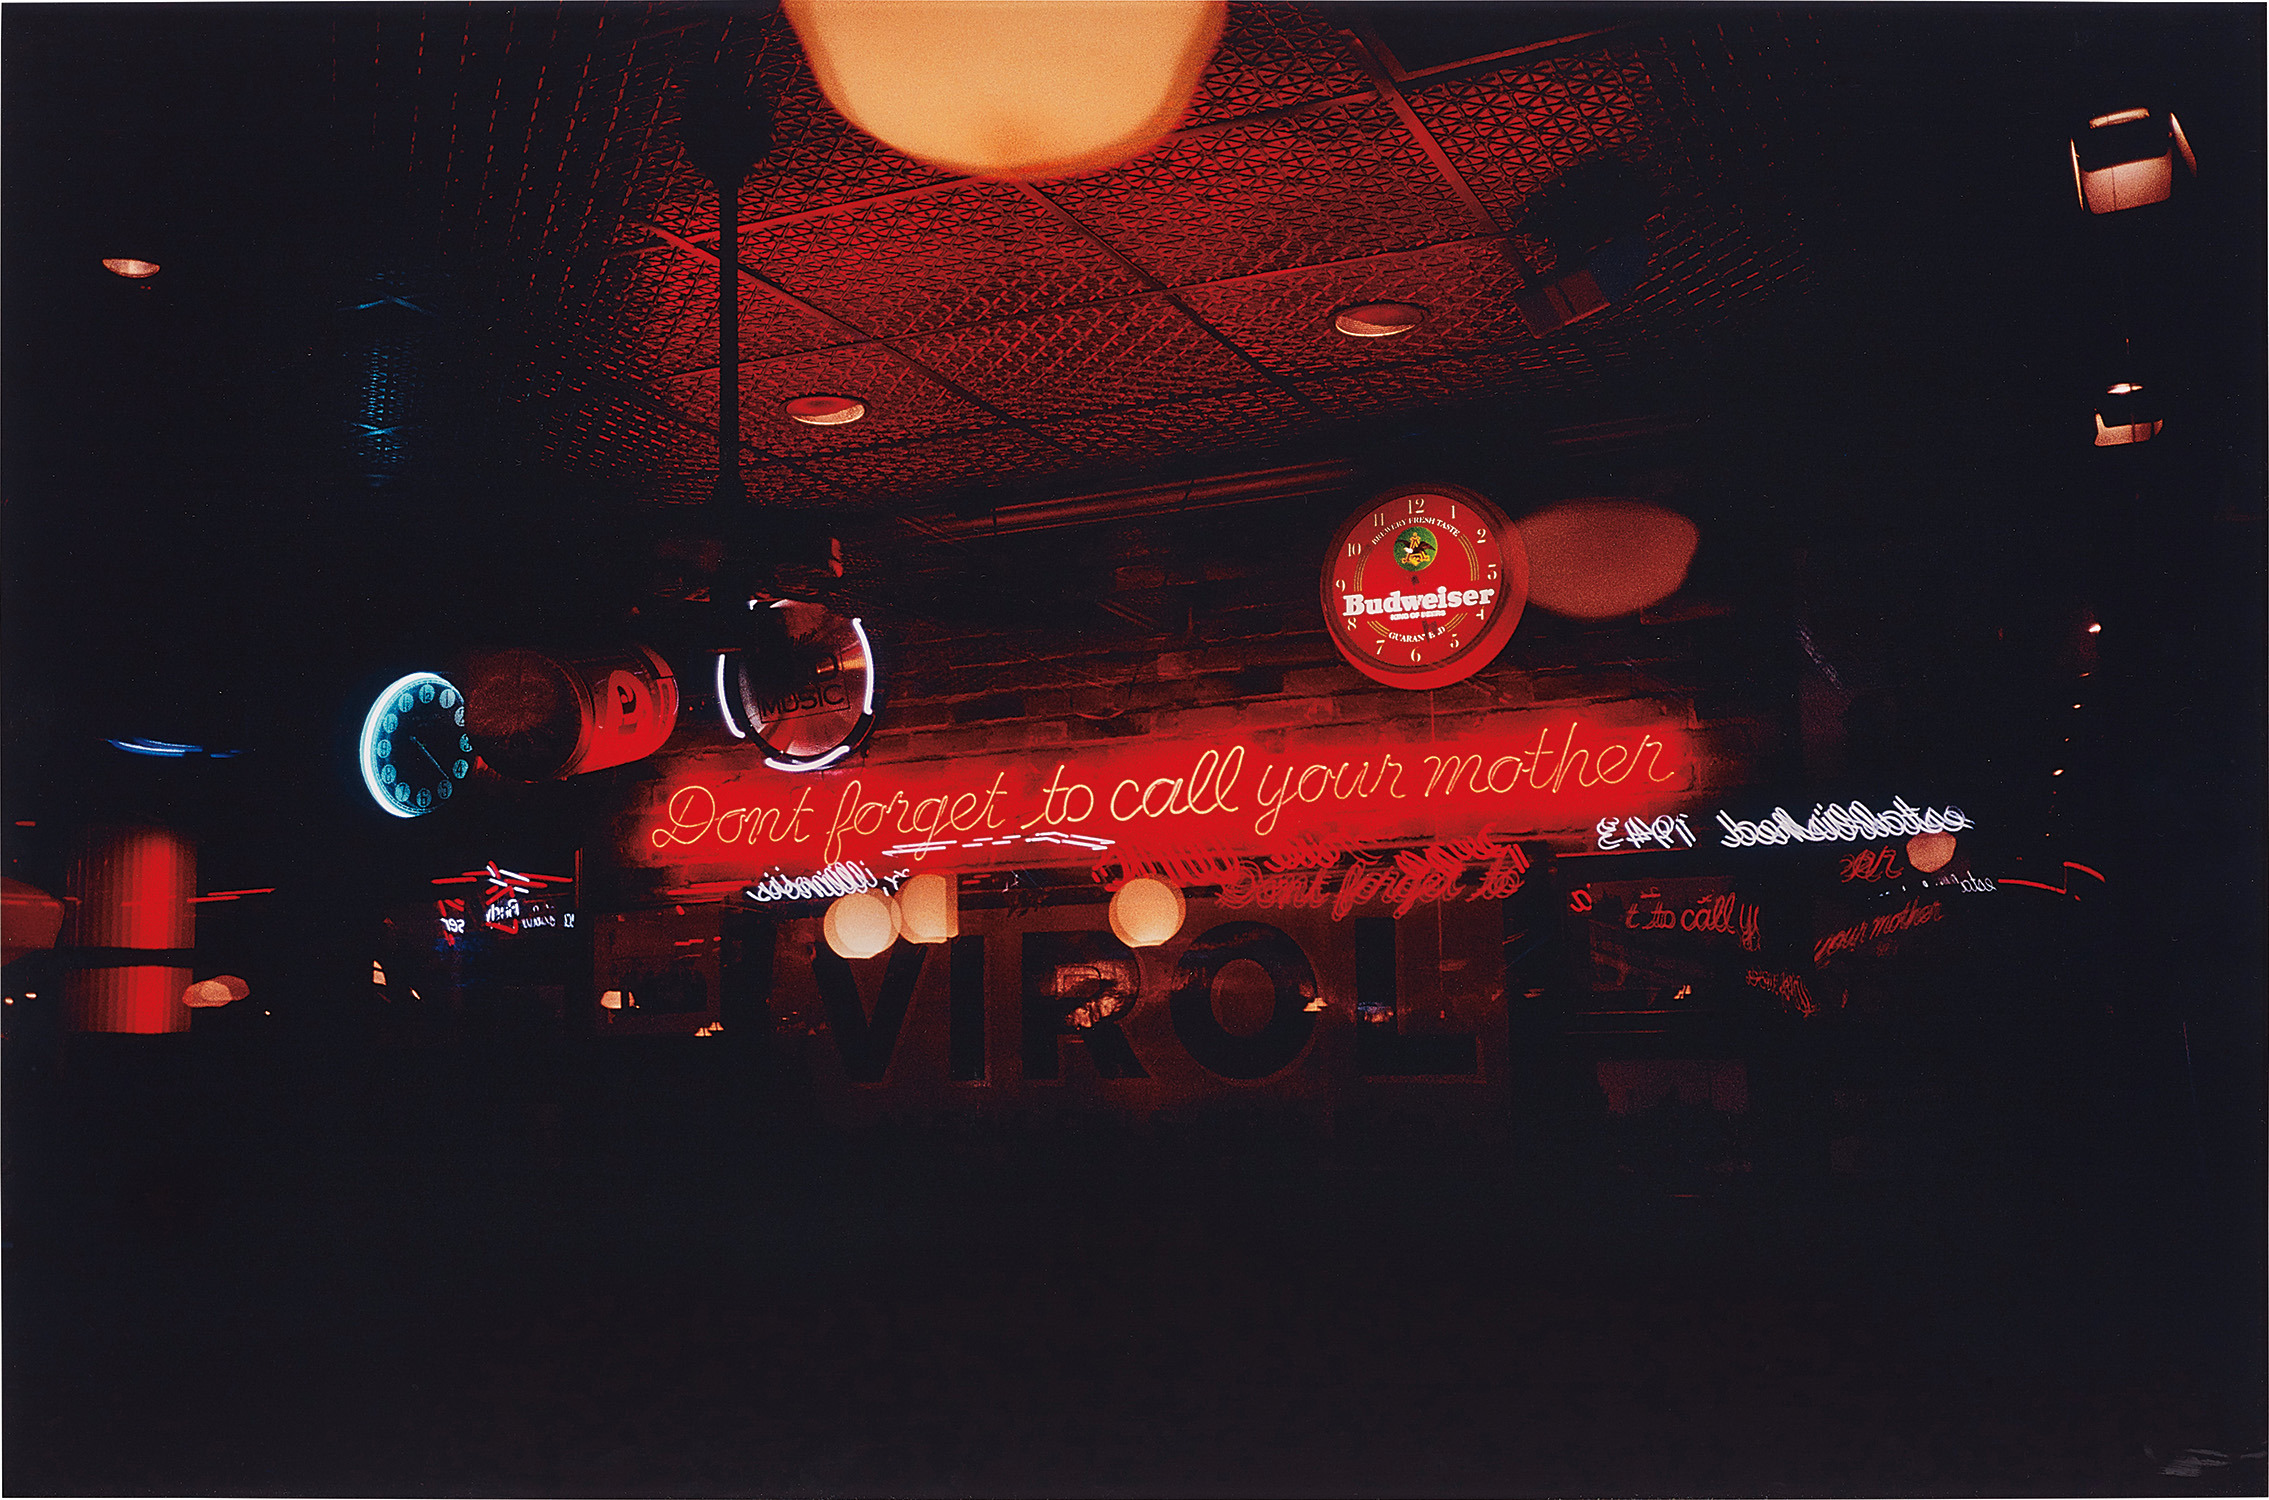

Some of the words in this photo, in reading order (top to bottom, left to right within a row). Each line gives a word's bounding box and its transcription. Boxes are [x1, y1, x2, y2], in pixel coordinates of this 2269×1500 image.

[1408, 498, 1425, 515] 12
[1374, 512, 1384, 527] 11
[1371, 518, 1407, 545] BREWERY
[1408, 516, 1436, 525] FRESH
[1436, 518, 1461, 537] TASTE
[1476, 528, 1487, 544] 2
[1347, 542, 1362, 557] 10
[1335, 579, 1346, 592] 9
[1342, 585, 1495, 617] Budweiser
[1347, 617, 1357, 631] 8
[1375, 640, 1386, 655] 7
[1449, 633, 1460, 649] 5
[1410, 646, 1422, 663] 6
[761, 683, 845, 717] MUSIC
[652, 785, 813, 847] Dont
[825, 772, 1007, 866] forget
[1020, 765, 1094, 830] to
[1109, 745, 1245, 821] call
[1255, 753, 1406, 835] your
[1424, 722, 1675, 798] mother
[808, 920, 1484, 1086] VIROL
